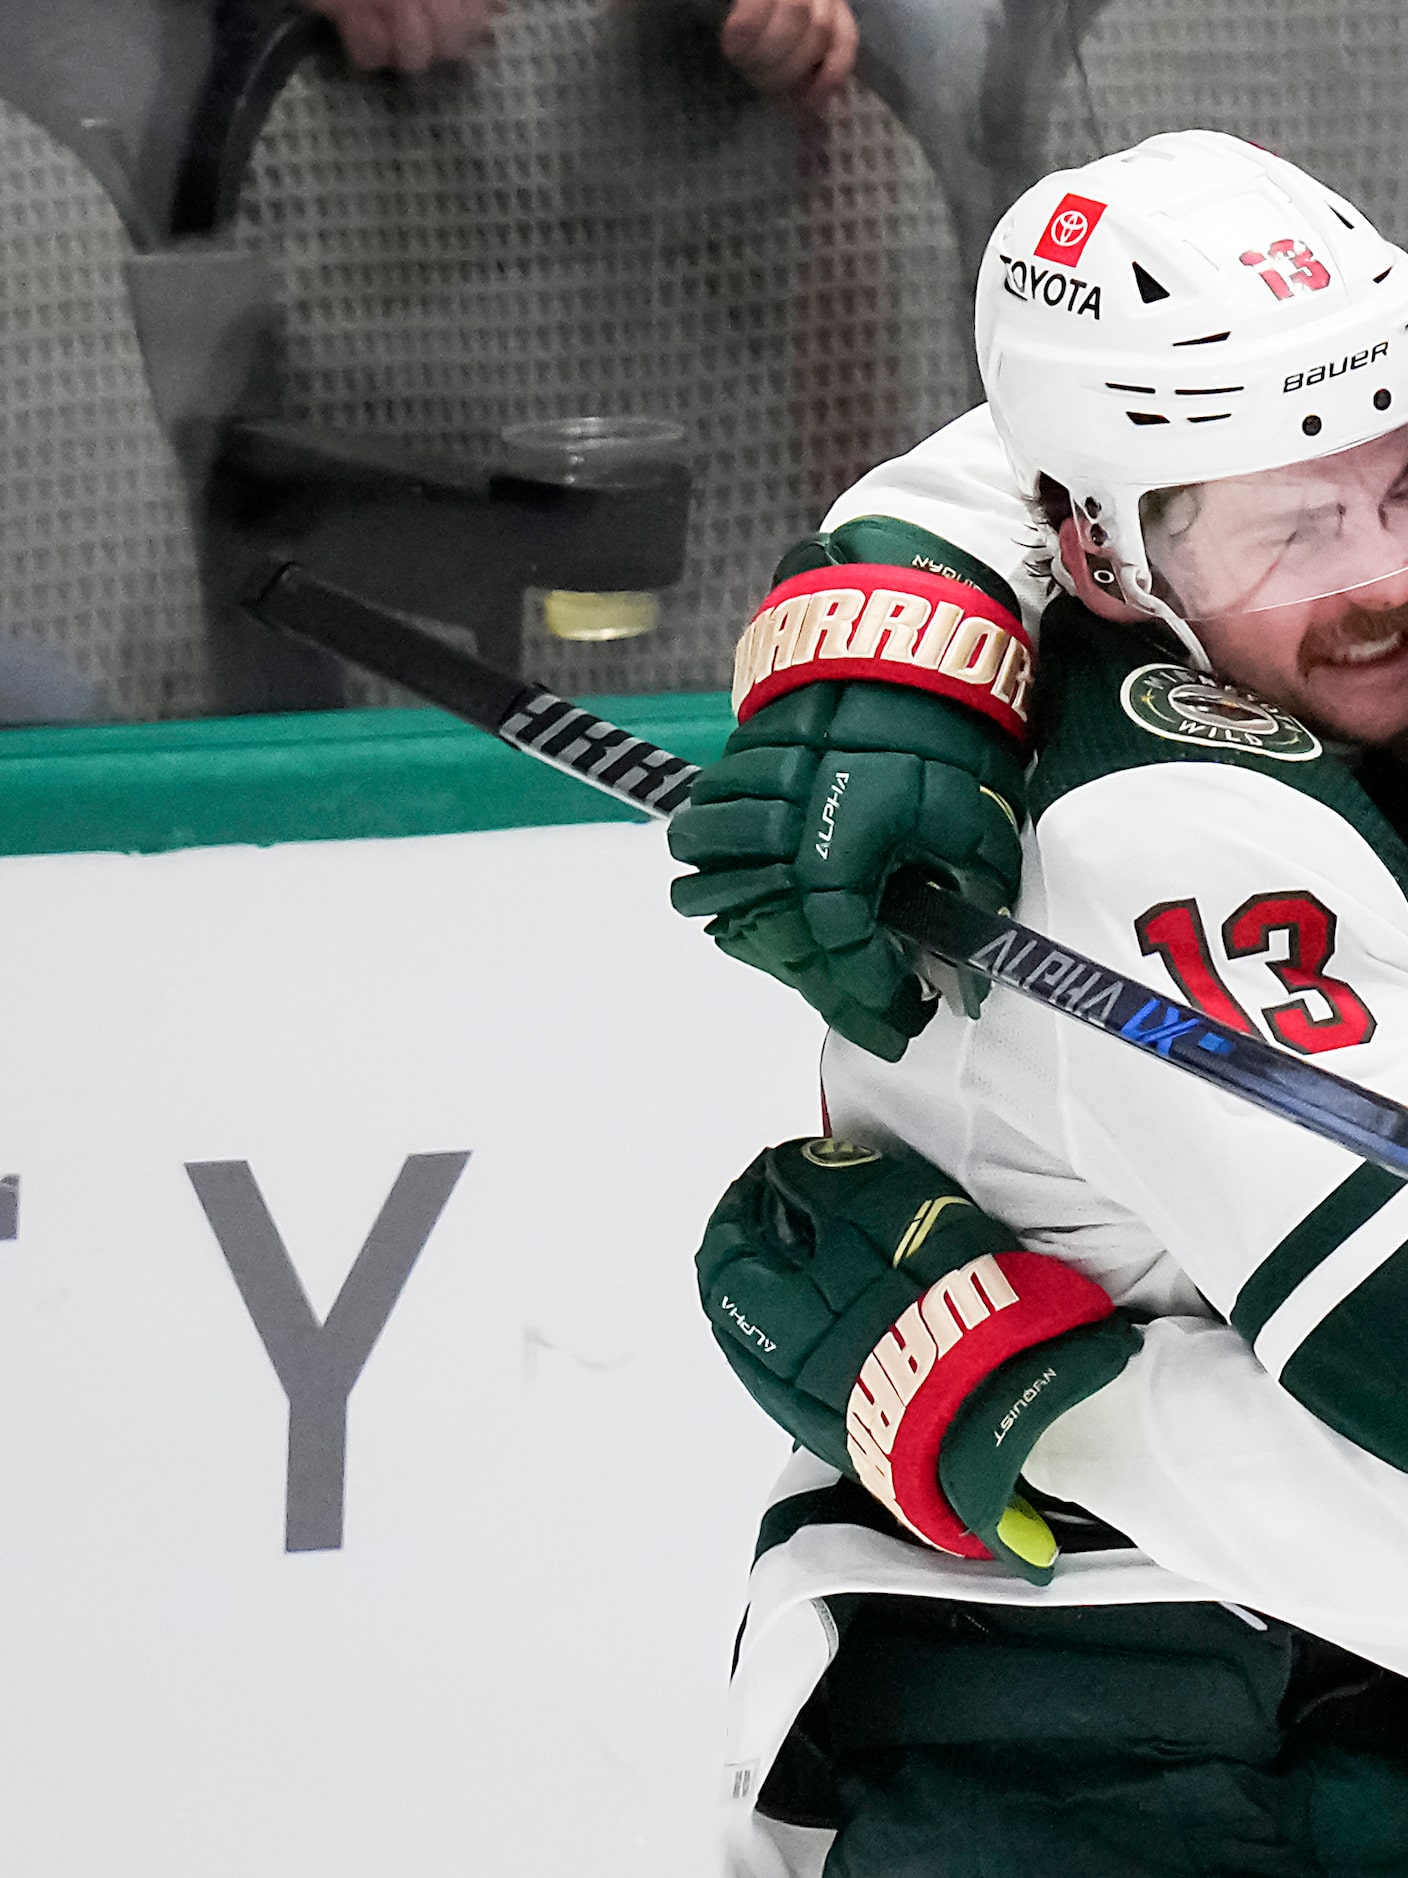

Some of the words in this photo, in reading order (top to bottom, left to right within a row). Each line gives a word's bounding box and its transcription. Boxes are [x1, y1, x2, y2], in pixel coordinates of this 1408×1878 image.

[999, 254, 1101, 320] TOYOTA
[1238, 238, 1332, 302] 13
[1283, 341, 1389, 393] BAUER
[732, 588, 1034, 724] WARRIOR
[1178, 719, 1263, 746] WILD
[815, 770, 850, 861] ALPHA
[968, 929, 1125, 1028] ALPHA
[1134, 889, 1378, 1055] 13
[719, 1295, 777, 1353] ALPHA
[995, 1367, 1056, 1448] NYQUIST
